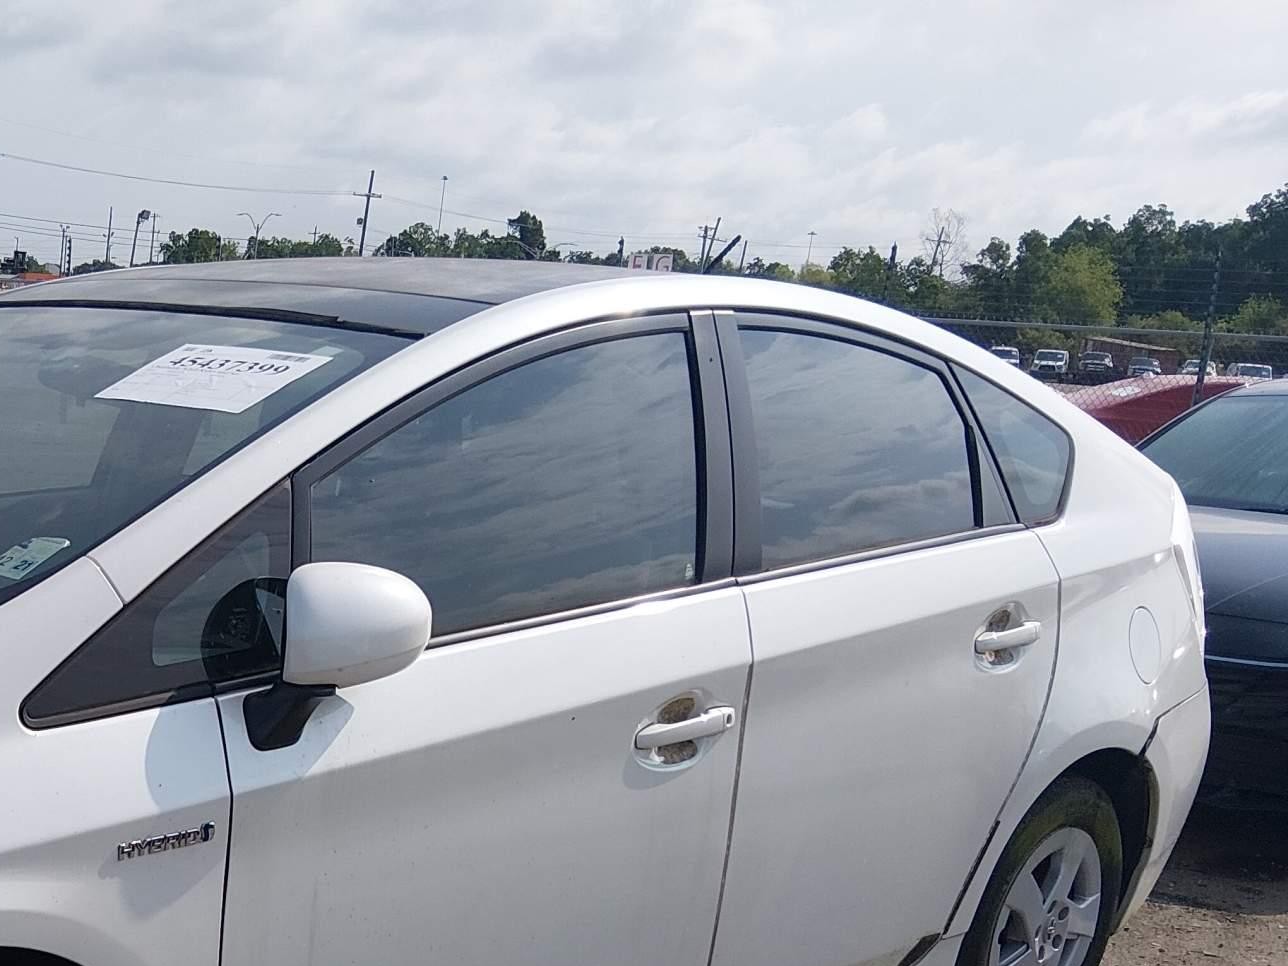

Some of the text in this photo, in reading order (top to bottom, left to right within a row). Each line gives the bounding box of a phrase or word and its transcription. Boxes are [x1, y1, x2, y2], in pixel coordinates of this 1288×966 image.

[170, 355, 290, 376] 45437399
[13, 560, 34, 571] 21
[117, 828, 200, 861] HYBRID
